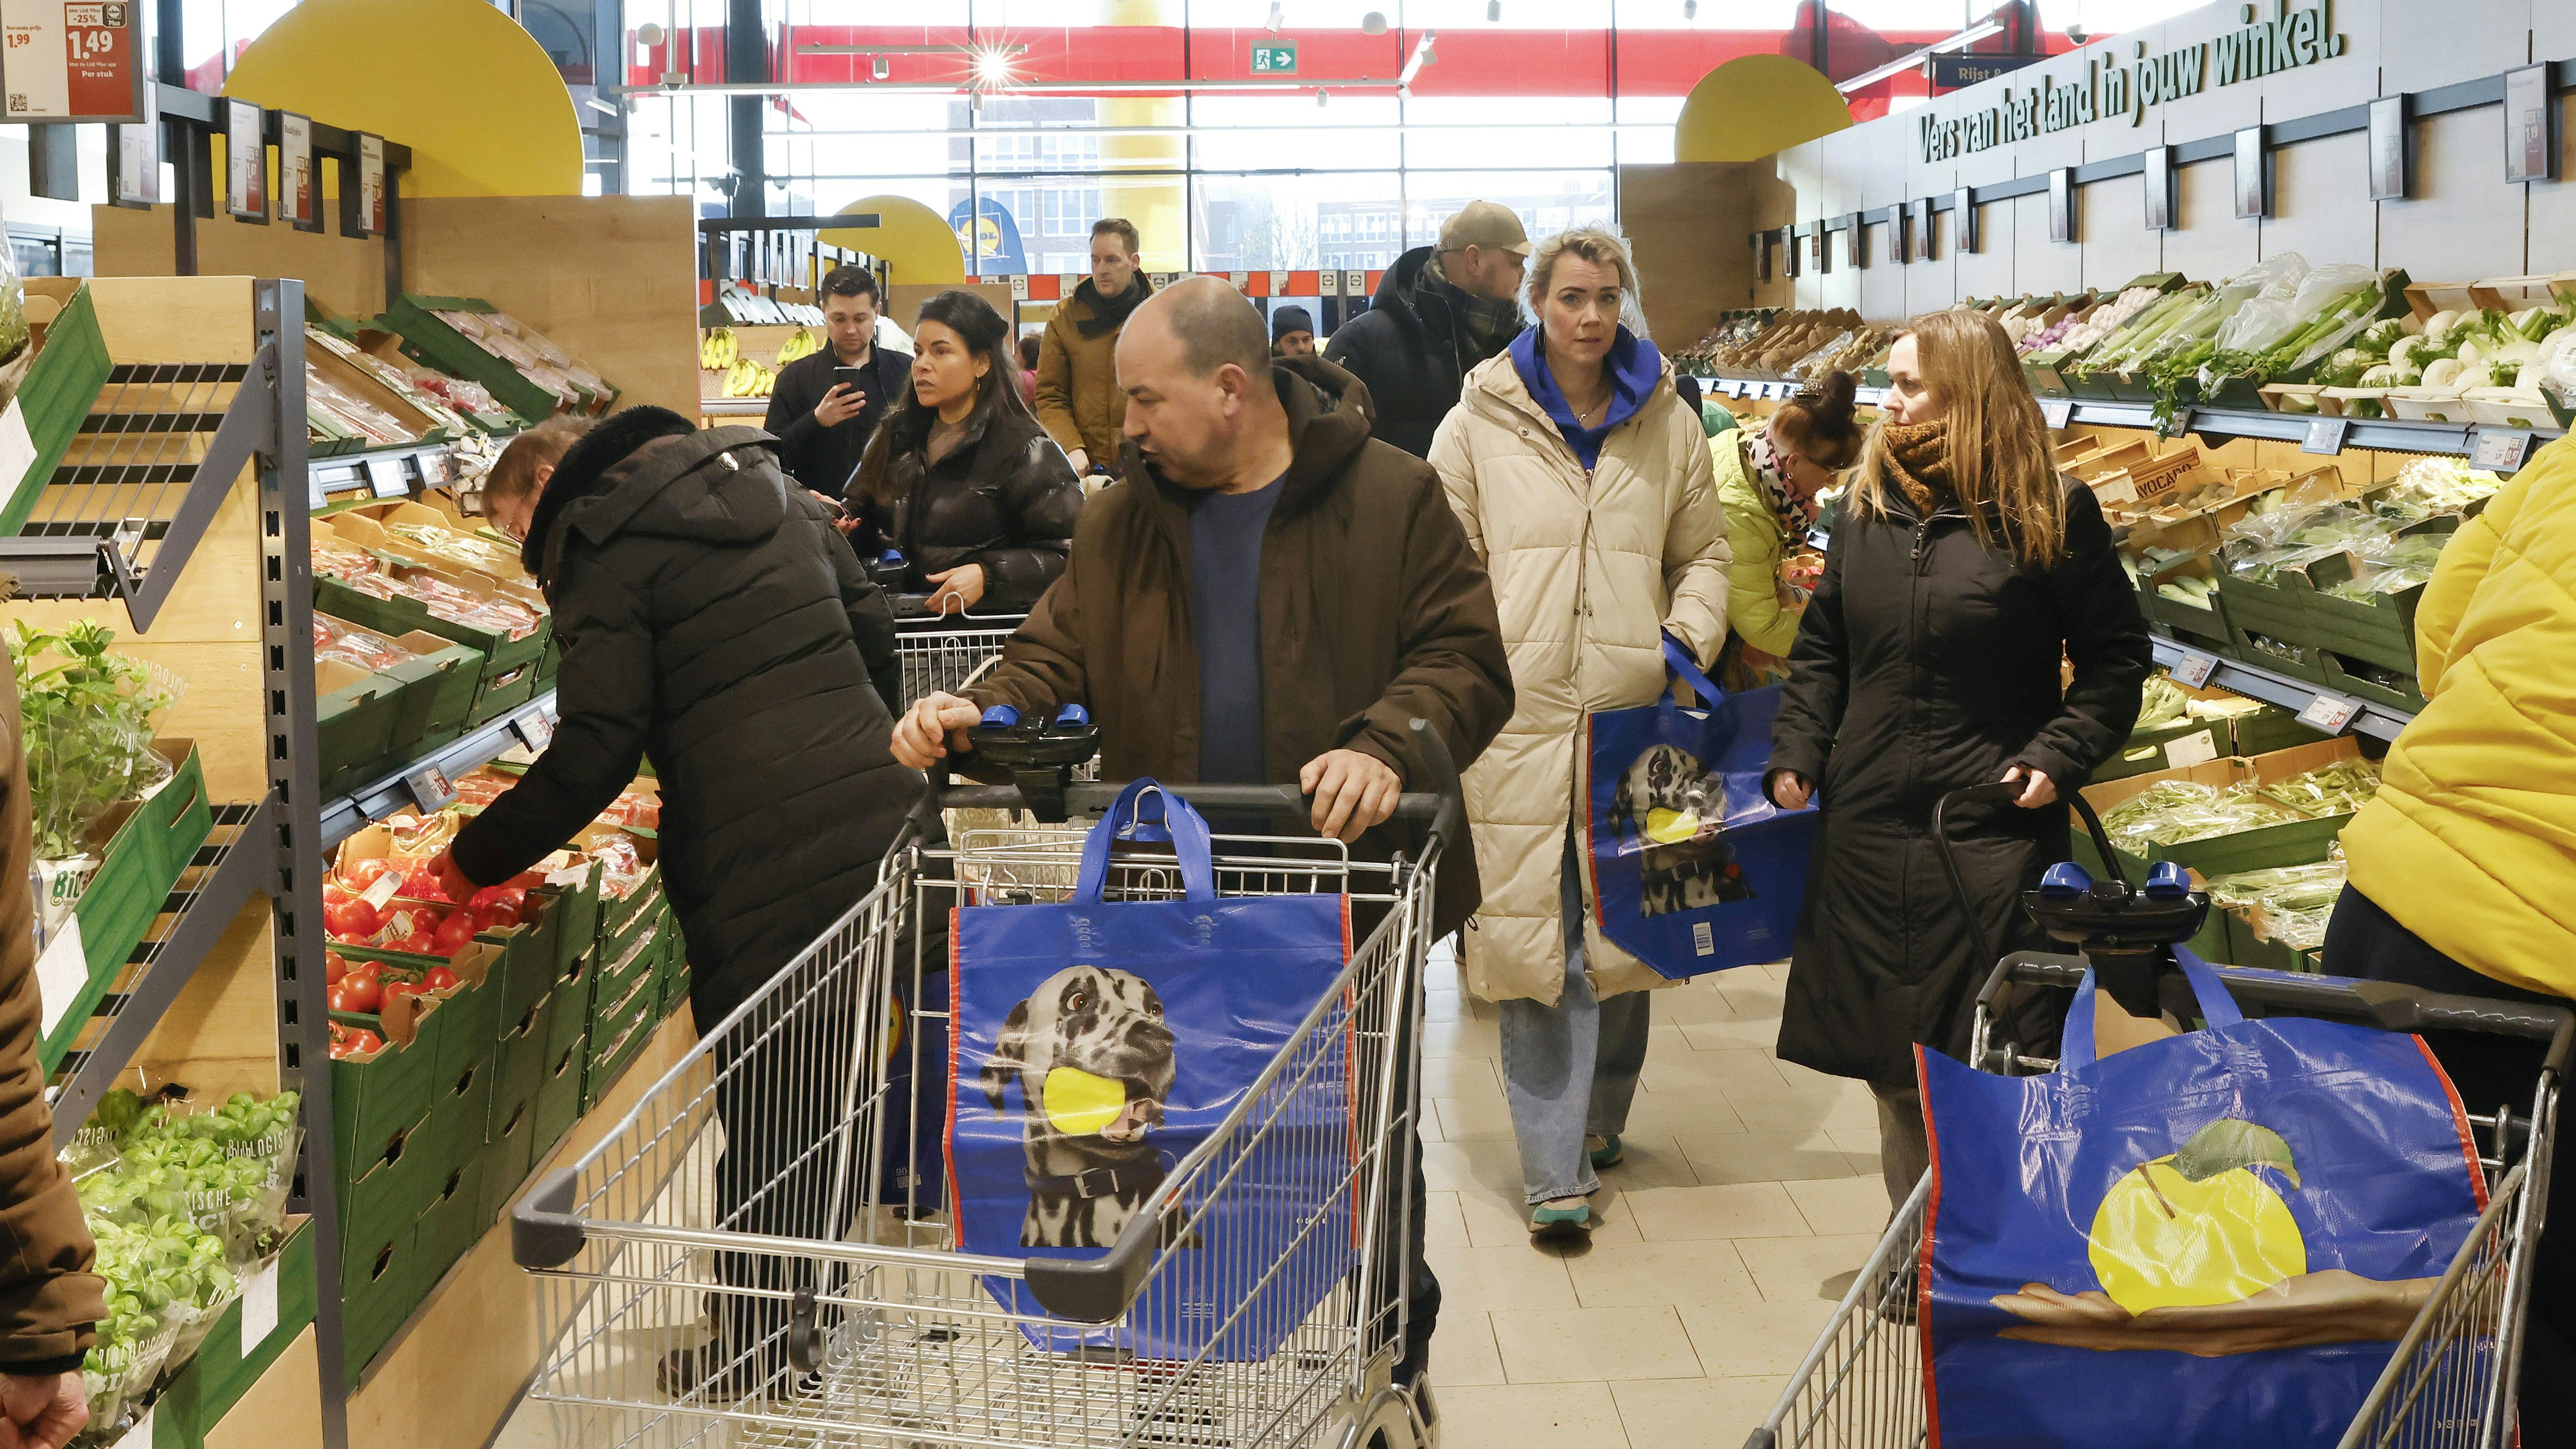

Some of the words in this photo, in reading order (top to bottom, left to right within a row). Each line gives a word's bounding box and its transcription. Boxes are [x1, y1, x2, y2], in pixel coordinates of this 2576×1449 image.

[73, 15, 97, 23] -25%
[7, 34, 30, 48] 1.99
[68, 31, 113, 60] 1.49
[1918, 113, 1956, 163] Vers
[1959, 107, 1997, 153] van
[2001, 87, 2037, 143] het
[2040, 59, 2094, 133] land
[2099, 51, 2128, 117] in
[2130, 40, 2207, 128] jouw
[2210, 0, 2344, 86] winkel.
[1958, 66, 1990, 82] Rijst
